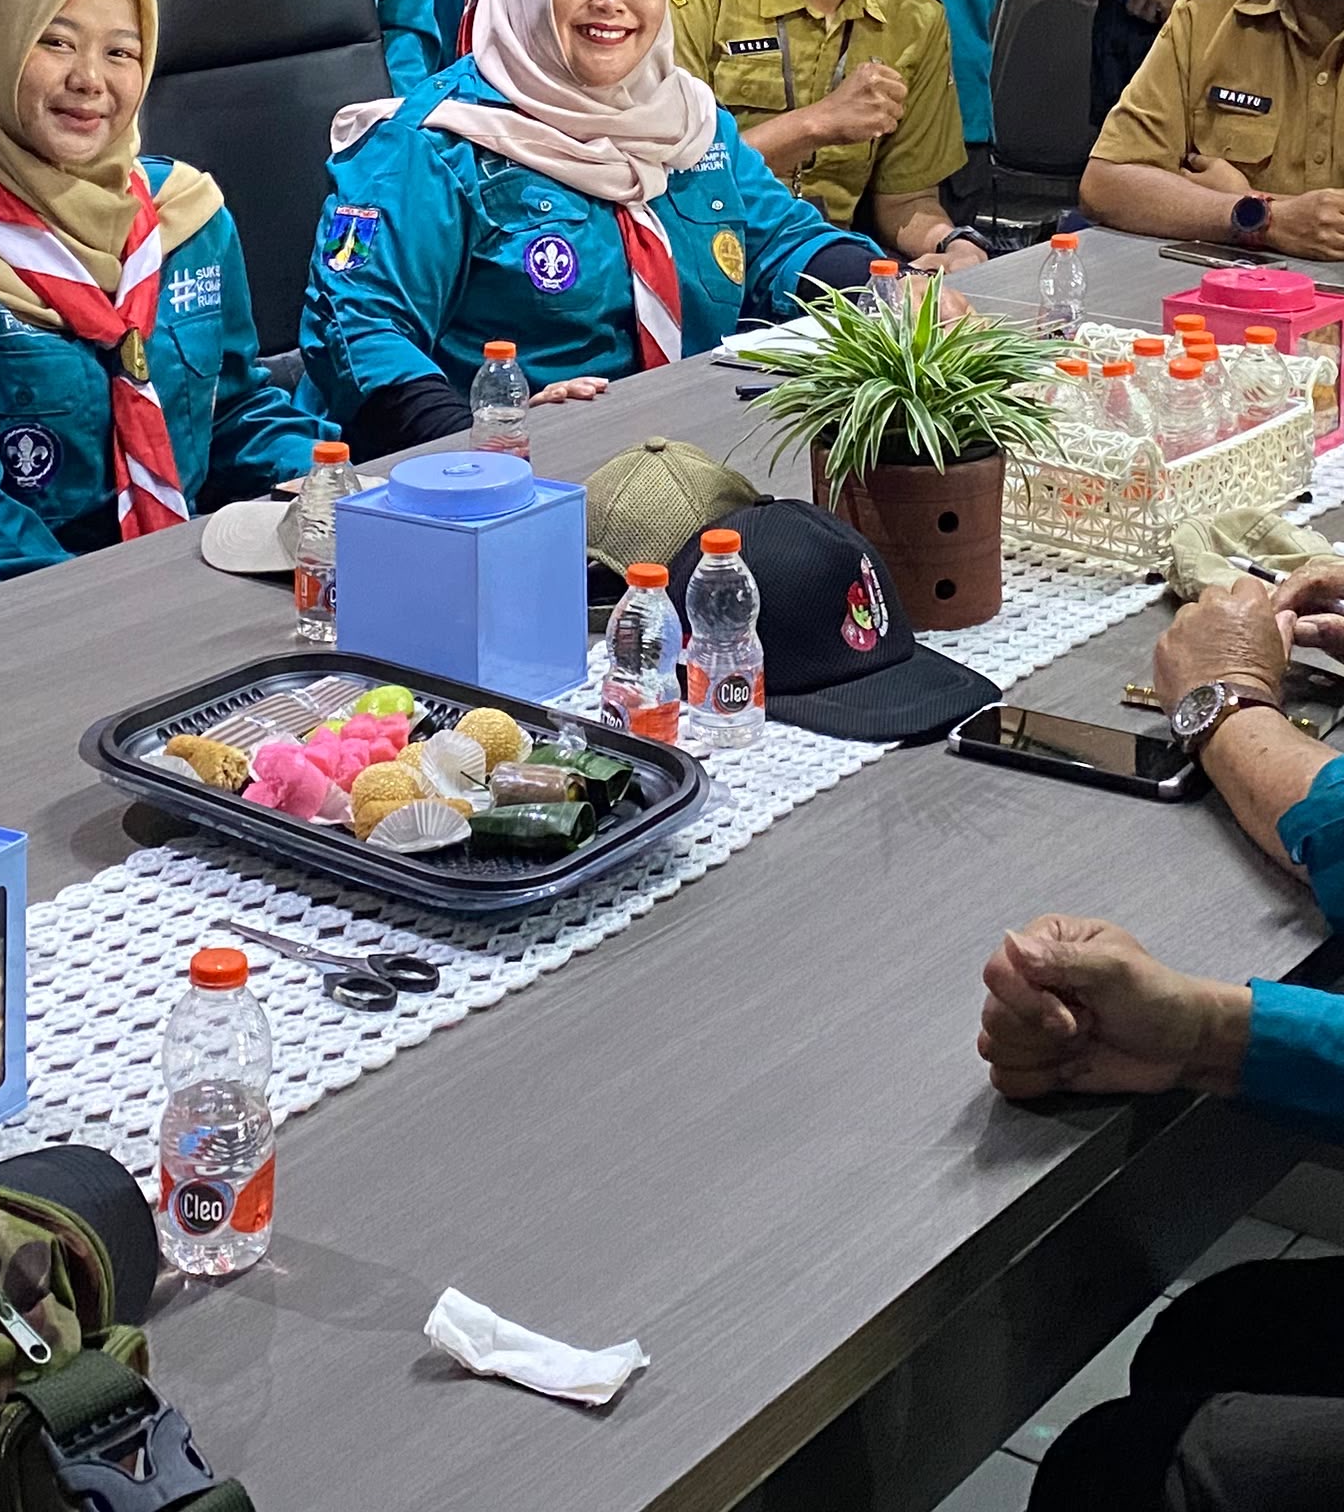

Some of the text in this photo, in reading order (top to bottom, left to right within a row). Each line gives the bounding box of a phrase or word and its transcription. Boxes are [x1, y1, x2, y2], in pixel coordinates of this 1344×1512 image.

[1218, 88, 1262, 107] WAHYU
[720, 683, 750, 704] Cleo
[183, 1193, 223, 1222] Cleo
